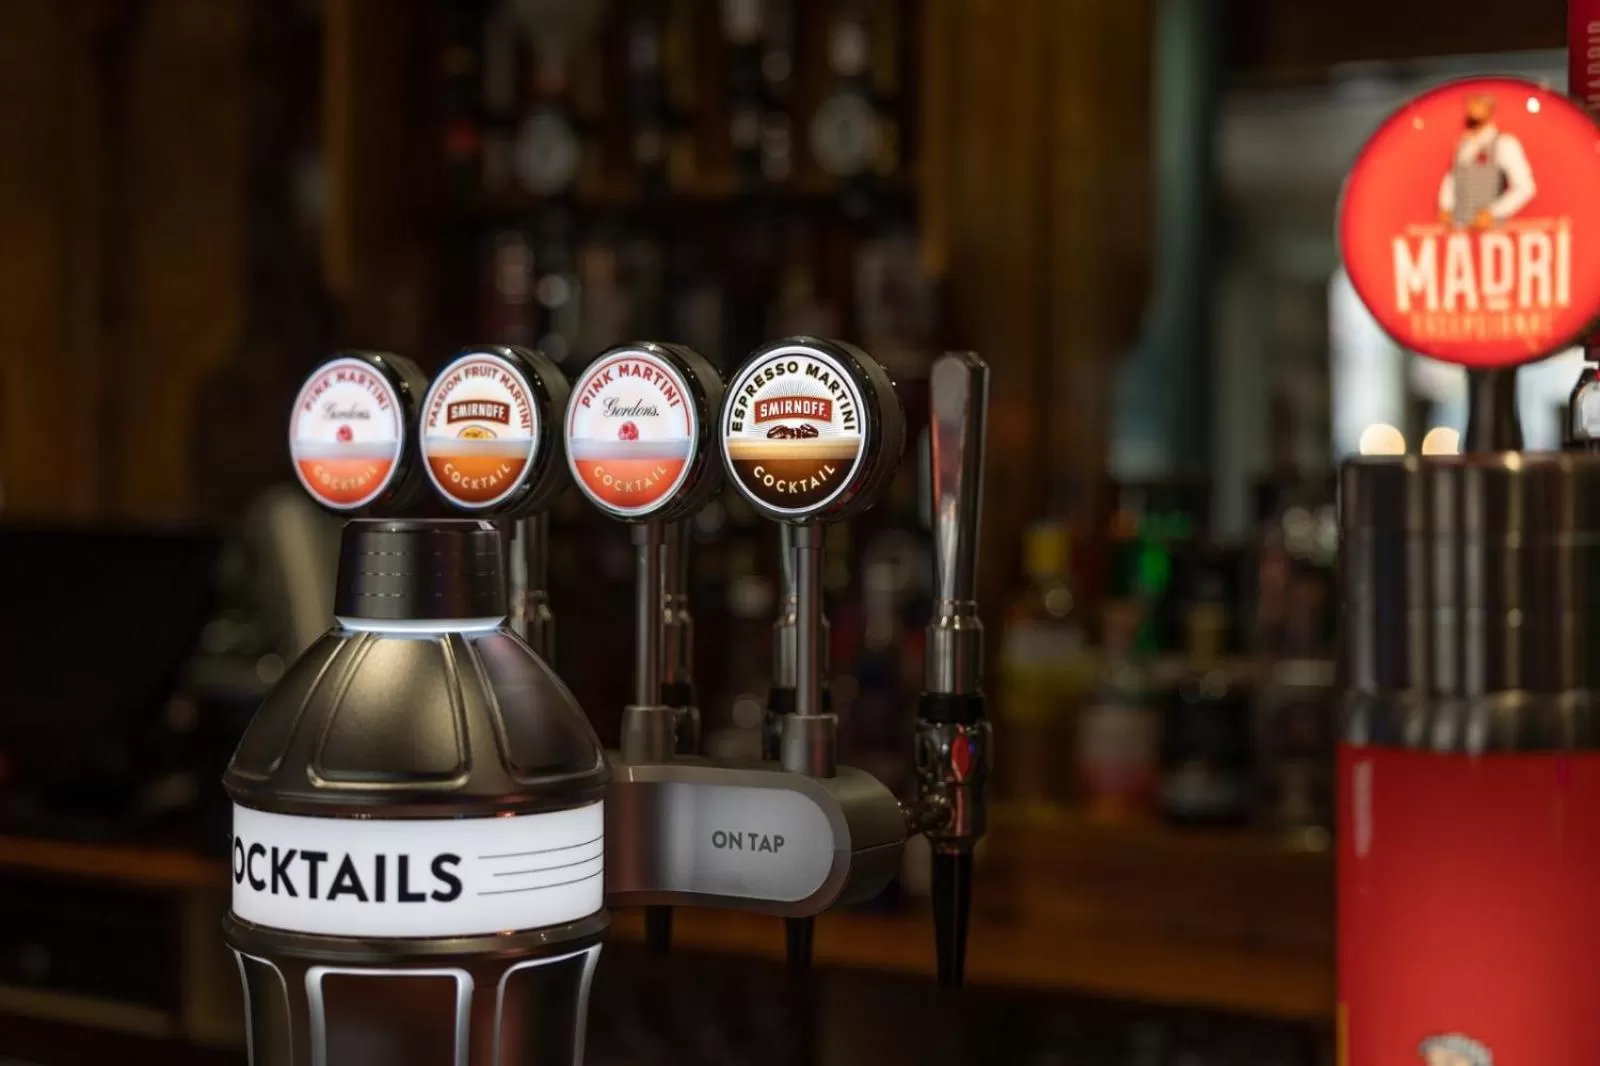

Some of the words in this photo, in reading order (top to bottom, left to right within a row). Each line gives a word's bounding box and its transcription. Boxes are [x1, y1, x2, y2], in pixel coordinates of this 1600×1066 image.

[303, 379, 331, 412] PINK
[336, 371, 390, 410] MARTINI
[429, 374, 463, 428] PASSION
[464, 366, 499, 379] FRUIT
[500, 375, 531, 429] MARTINI
[582, 371, 614, 409] PINK
[619, 364, 681, 408] MARTINI
[732, 361, 799, 432] ESPRESSO
[806, 363, 855, 431] MARTINI
[312, 464, 378, 490] COCKTAIL
[444, 463, 511, 489] COCKTAIL
[594, 465, 667, 493] COCKTAIL
[753, 464, 836, 494] COCKTAIL
[711, 830, 743, 850] ON
[748, 832, 785, 853] TAP
